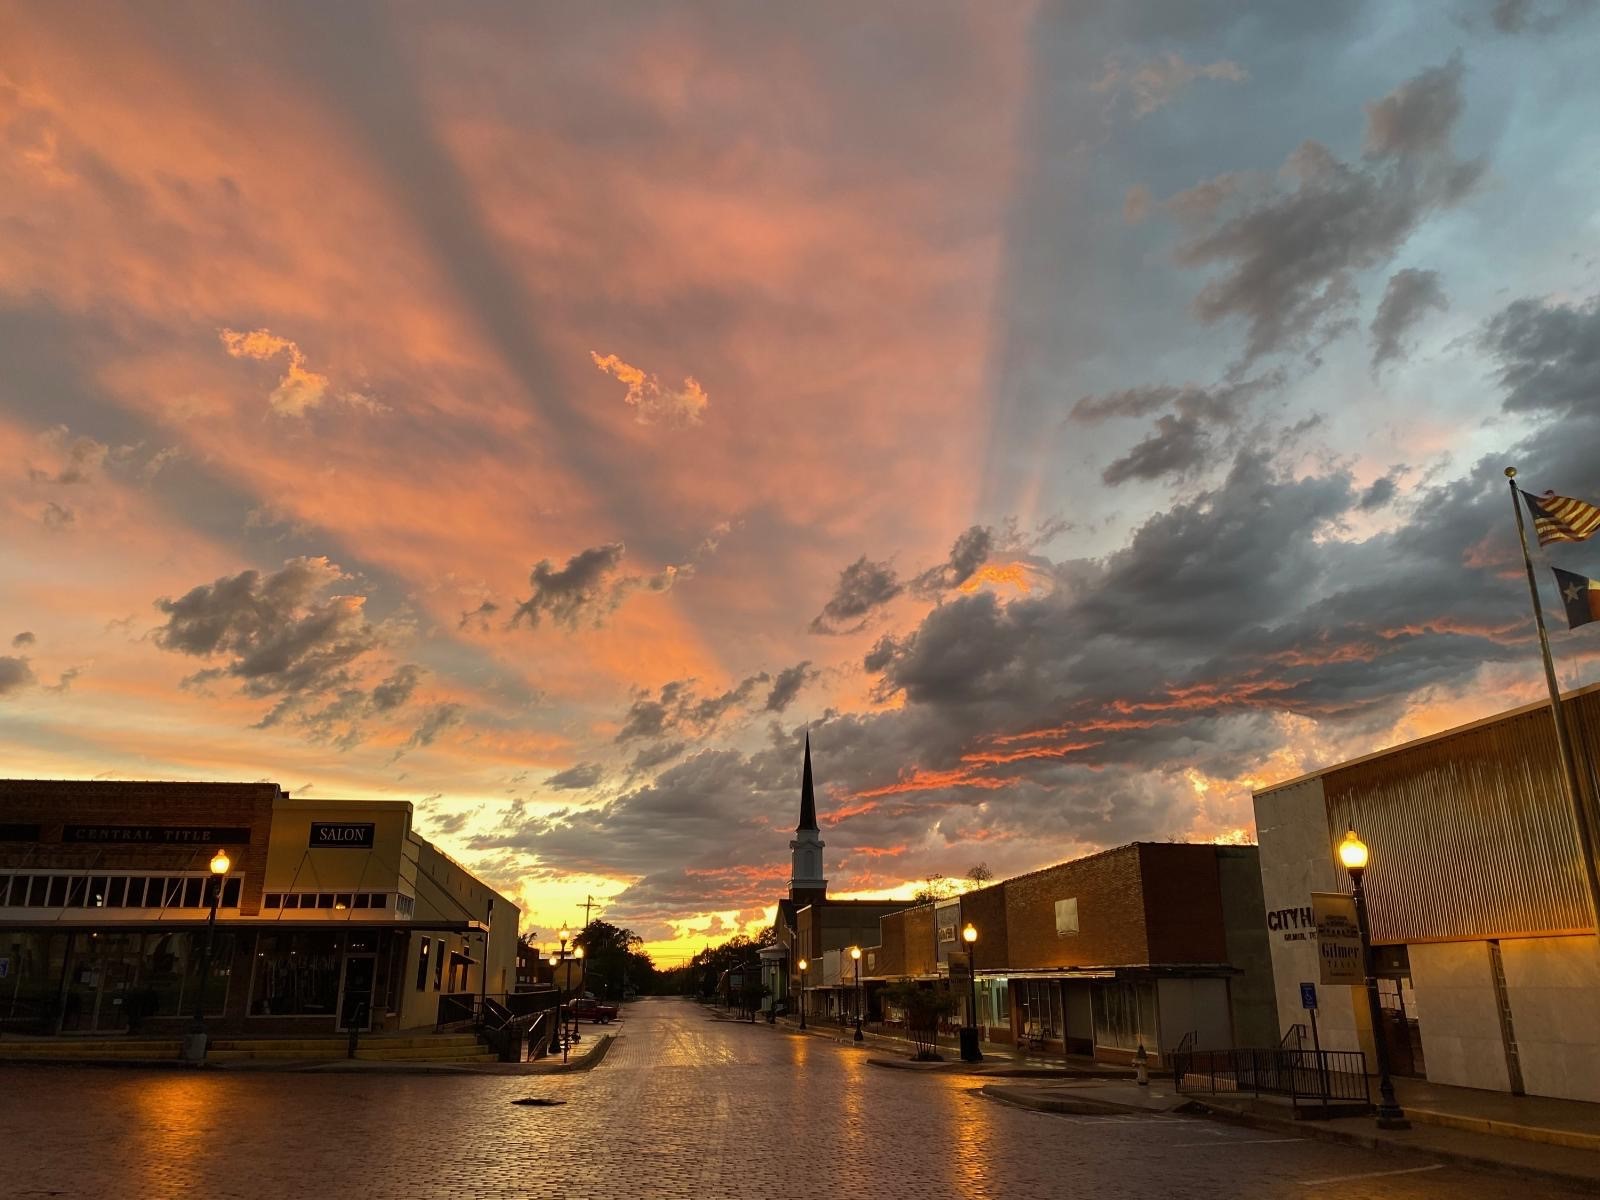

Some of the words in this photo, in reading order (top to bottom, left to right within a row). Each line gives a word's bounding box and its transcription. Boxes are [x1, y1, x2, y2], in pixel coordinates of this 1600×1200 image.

[76, 829, 153, 840] CENTRAL
[164, 830, 212, 841] TITLE
[319, 826, 367, 841] SALON
[1267, 908, 1298, 931] CITY
[1322, 942, 1360, 959] Gilmer
